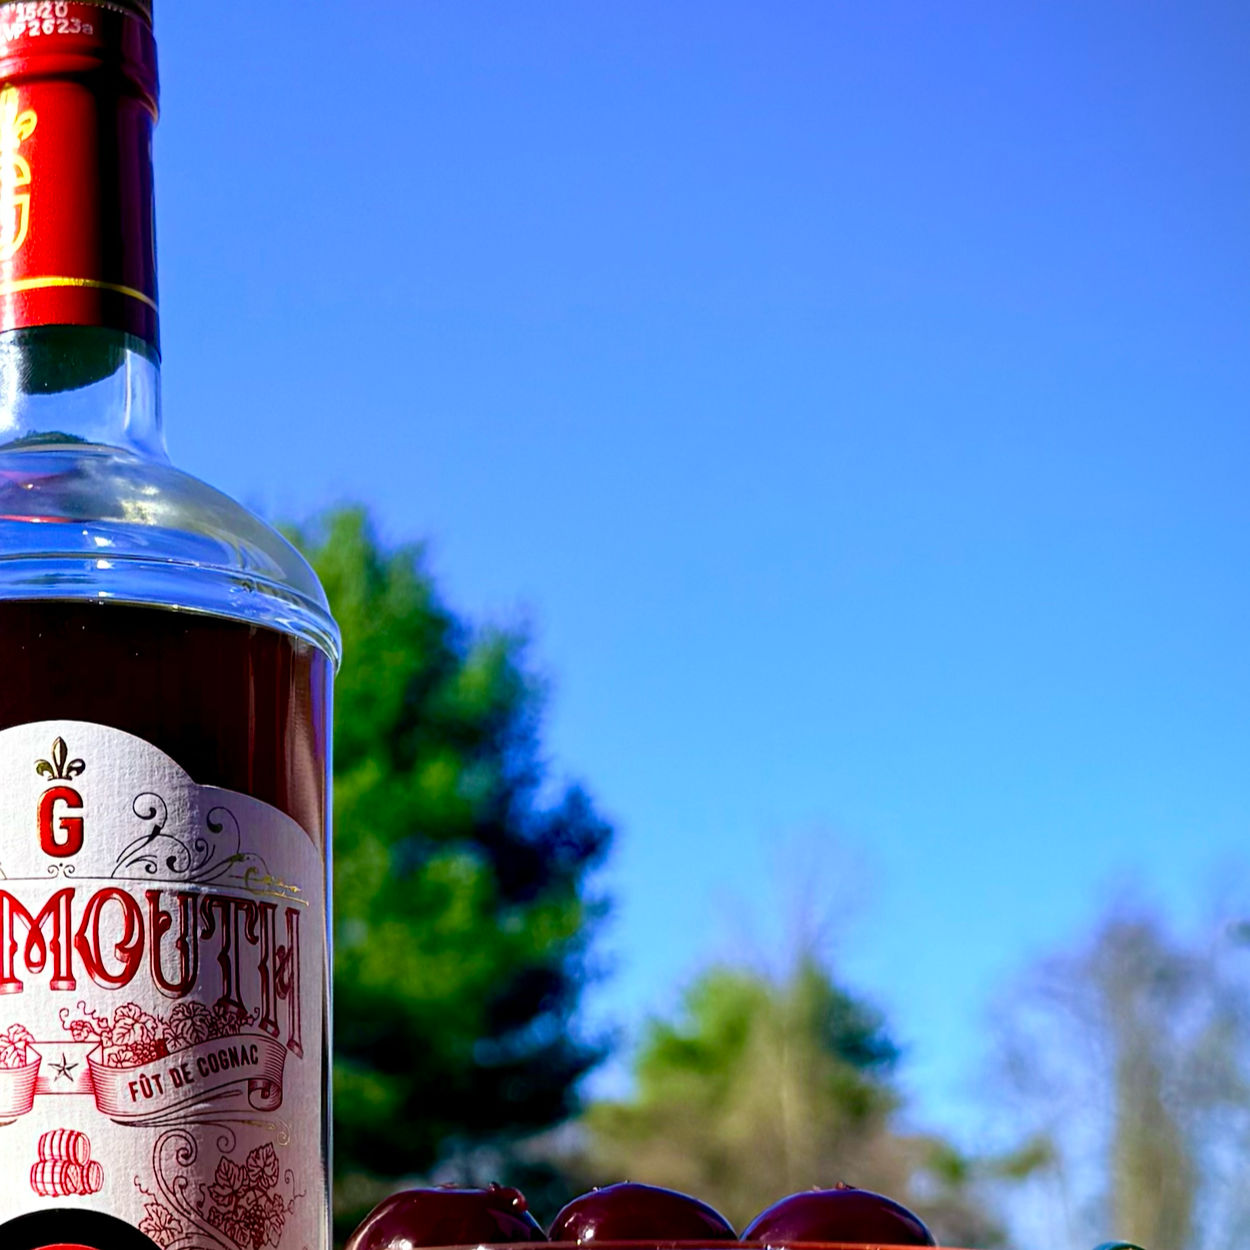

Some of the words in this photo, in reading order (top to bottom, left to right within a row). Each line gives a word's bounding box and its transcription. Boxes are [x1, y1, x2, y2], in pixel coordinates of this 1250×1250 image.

[37, 786, 83, 857] G
[128, 1072, 162, 1102] FÛT
[169, 1067, 194, 1087] DE
[196, 1045, 260, 1078] COGNAC
